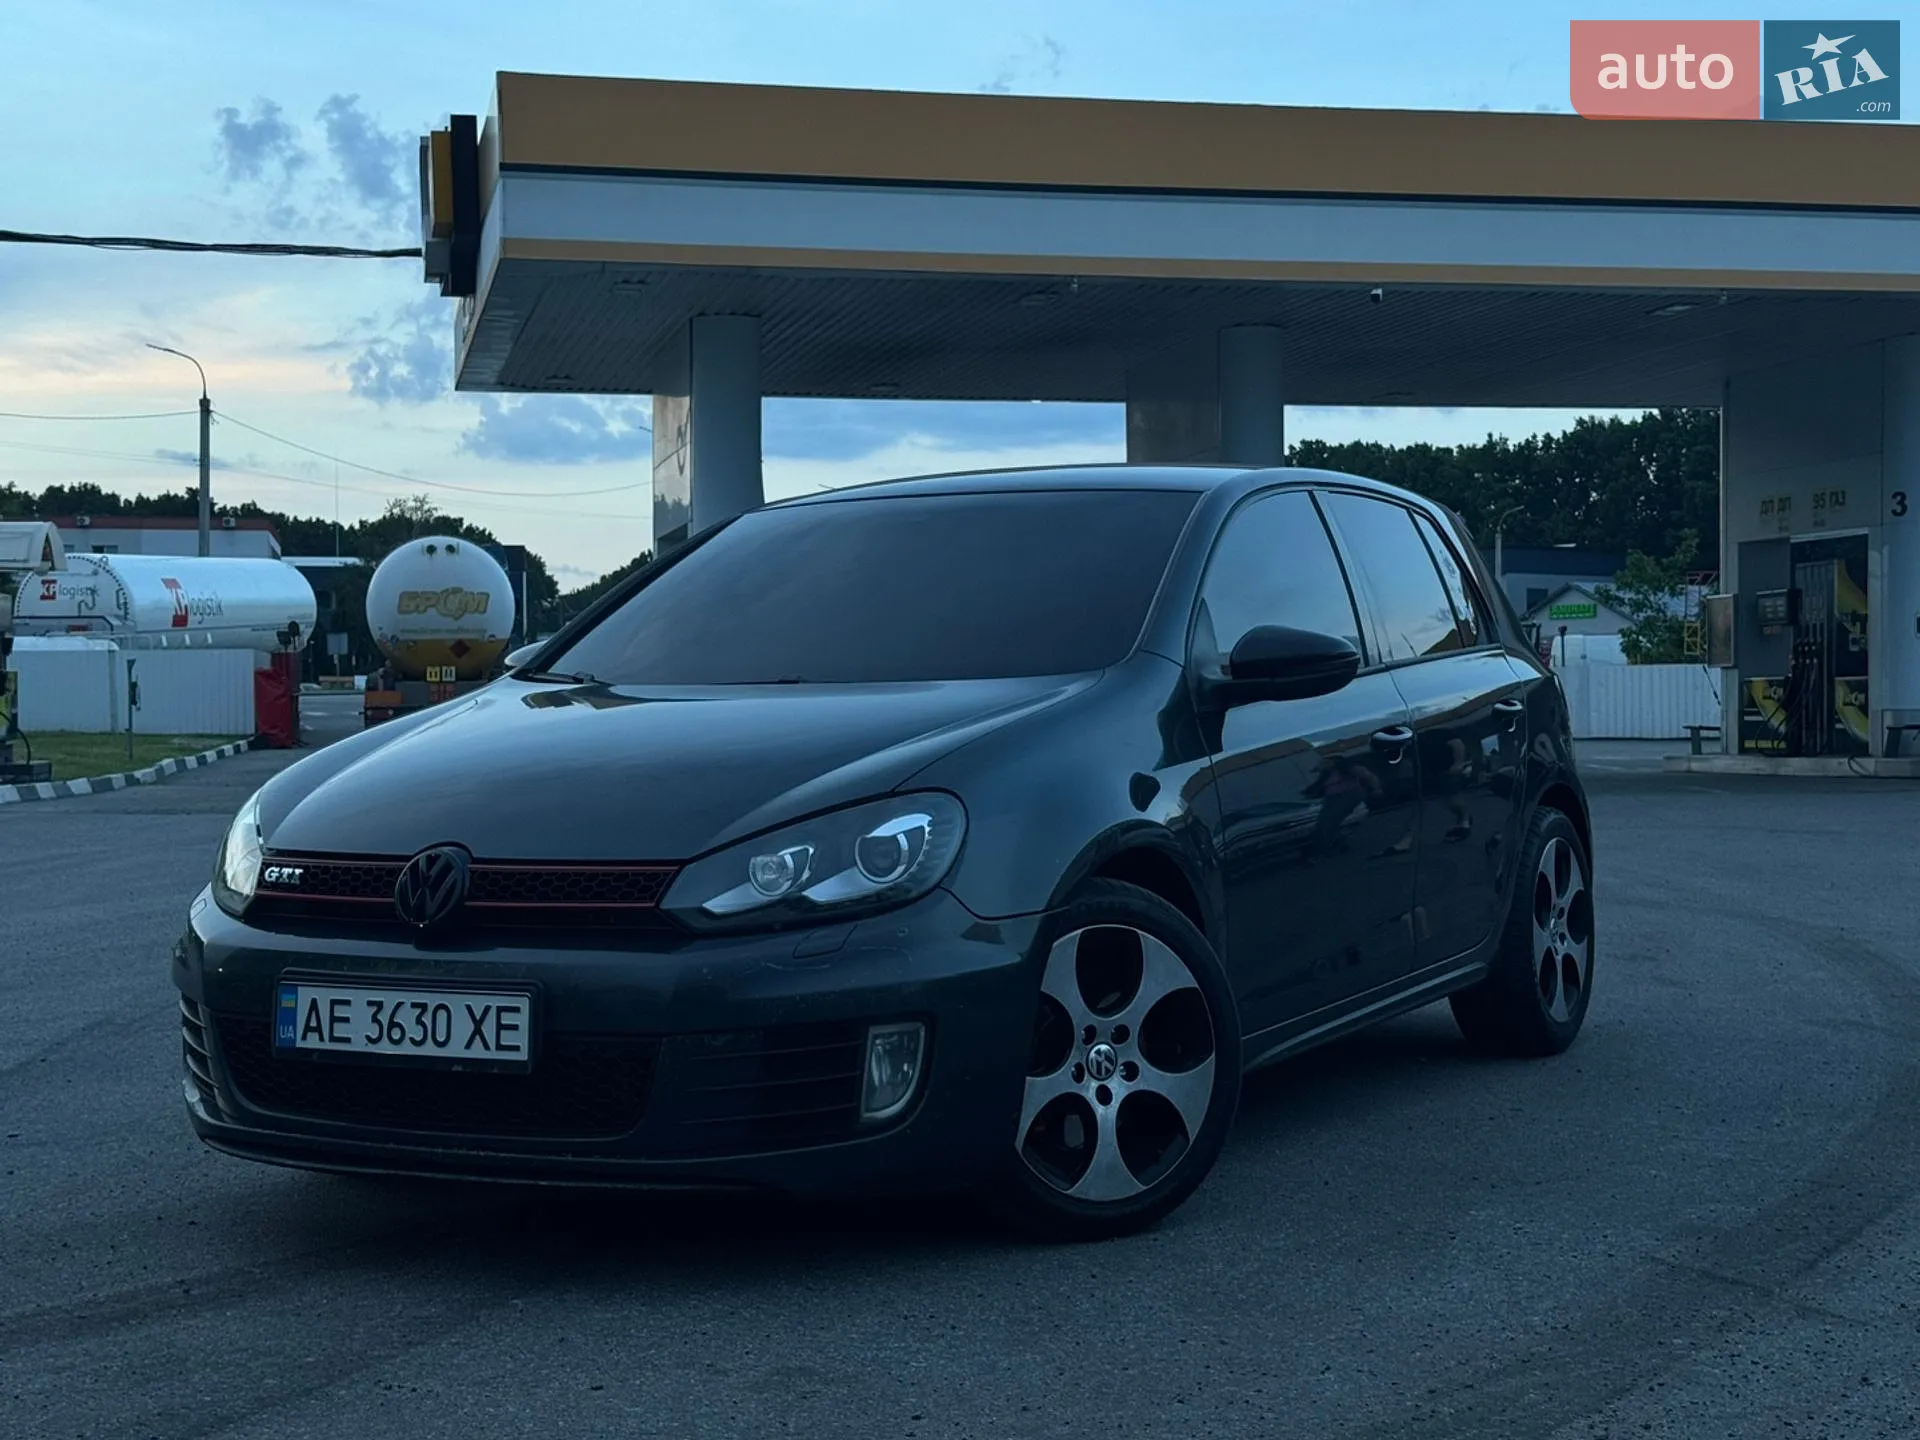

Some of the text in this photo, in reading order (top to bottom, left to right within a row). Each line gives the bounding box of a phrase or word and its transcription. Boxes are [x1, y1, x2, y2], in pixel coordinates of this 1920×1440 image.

[1813, 492, 1826, 510] 95
[1891, 491, 1908, 517] 3
[59, 583, 101, 597] logistik
[264, 866, 304, 885] GTI
[280, 1024, 295, 1040] UA
[301, 996, 522, 1053] AE 3630 XE
